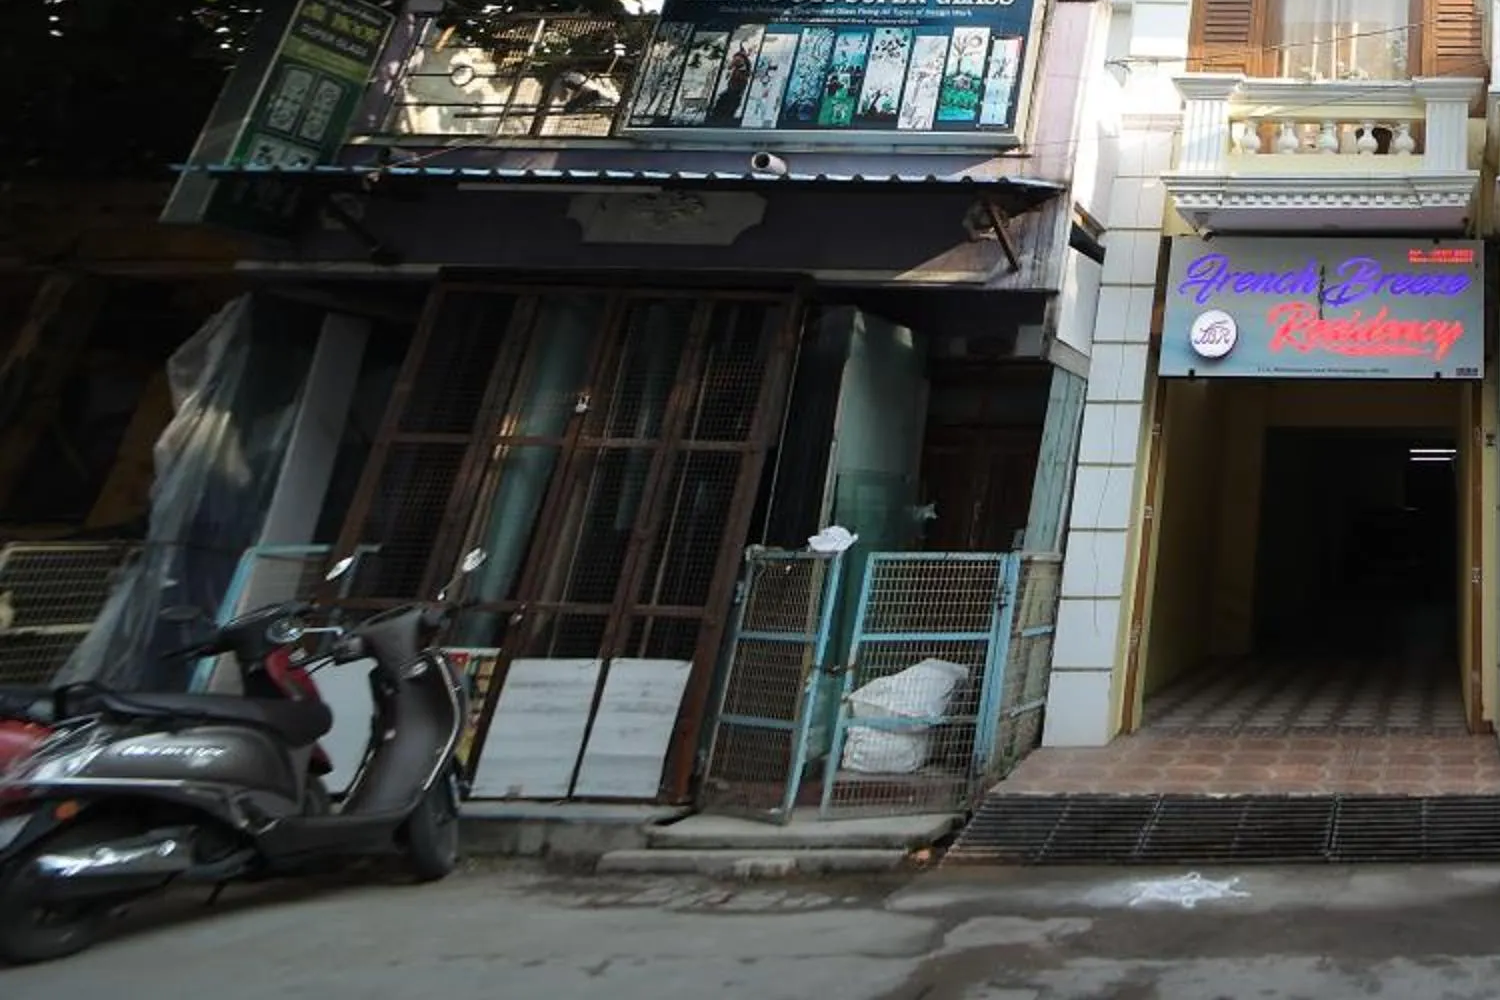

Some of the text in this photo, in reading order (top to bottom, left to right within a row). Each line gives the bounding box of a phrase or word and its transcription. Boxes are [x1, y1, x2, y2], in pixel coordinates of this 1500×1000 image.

[1179, 252, 1473, 308] French Breeze
[1267, 300, 1465, 362] Residency
